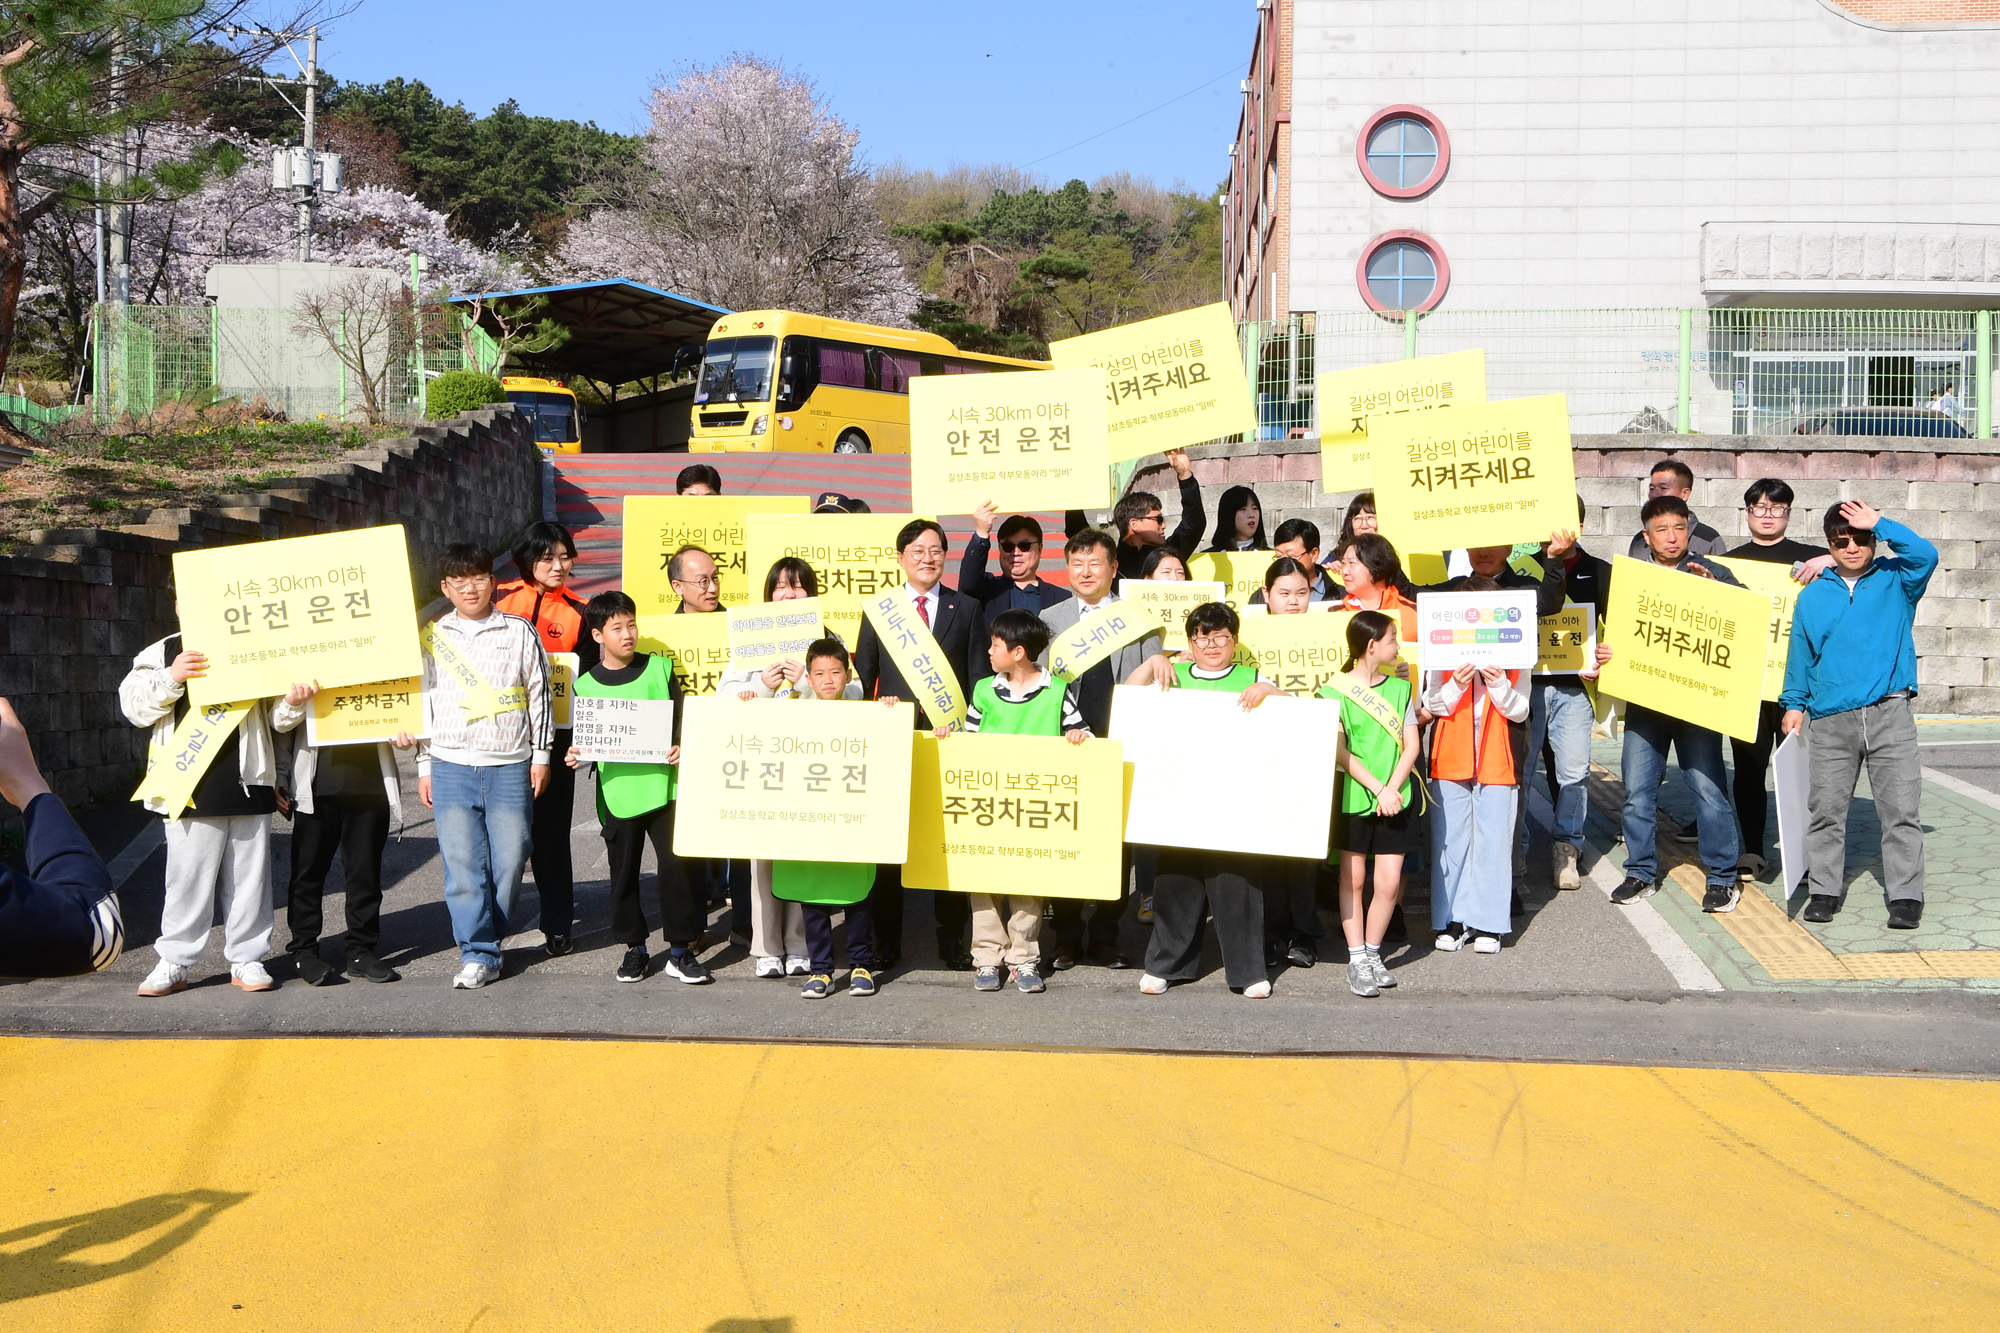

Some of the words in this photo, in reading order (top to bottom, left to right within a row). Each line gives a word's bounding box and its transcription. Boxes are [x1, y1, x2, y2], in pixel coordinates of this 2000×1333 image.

[1141, 338, 1204, 367] 어린이를
[1350, 393, 1391, 412] 길상의
[1396, 382, 1454, 404] 어린이를
[948, 406, 981, 425] 시속
[985, 405, 1032, 422] 30km
[1036, 402, 1070, 421] 이하
[1149, 404, 1194, 422] 학부모동아리
[1406, 438, 1457, 463] 길상의
[1462, 430, 1532, 456] 어린이를
[948, 472, 996, 483] 길상초등학교
[998, 469, 1047, 480] 학부모동아리
[1409, 456, 1536, 493] 지켜주세요
[1412, 507, 1462, 521] 길상초등학교
[1463, 501, 1513, 515] 학부모동아리
[660, 527, 707, 546] 길상의
[713, 527, 747, 546] 어린
[223, 580, 262, 600] 시속
[267, 573, 323, 594] 30km
[327, 564, 366, 586] 이하
[1141, 592, 1159, 602] 시속
[1164, 592, 1189, 602] 30km
[1193, 593, 1211, 603] 이하
[733, 616, 774, 632] 아이들은
[775, 612, 817, 628] 안전보행
[1562, 615, 1580, 627] 이하
[1637, 594, 1677, 623] 길상의
[1680, 606, 1736, 641] 어린이를
[229, 648, 287, 665] 길상초등학교
[289, 639, 347, 656] 학부모동아리
[735, 643, 776, 658] 어른들은
[1633, 619, 1732, 670] 지켜주세요
[878, 597, 918, 650] 모두가
[912, 653, 955, 714] 안전한
[1629, 659, 1667, 680] 길상초등학교
[1668, 672, 1708, 693] 학부모동아리
[334, 692, 410, 712] 주정차금지
[576, 698, 605, 709] 신호를
[609, 700, 638, 711] 지키는
[348, 718, 380, 727] 길상초등학교
[382, 717, 399, 725] 학생회
[575, 710, 598, 721] 일은,
[575, 722, 604, 735] 생명을
[608, 724, 637, 735] 지키는
[175, 728, 209, 772] 길상
[574, 735, 622, 747] 일입니다!!
[726, 733, 764, 755] 시속
[769, 736, 824, 755] 30km
[830, 737, 869, 758] 이하
[945, 769, 999, 791] 어린이
[1004, 772, 1078, 796] 보호구역
[719, 809, 776, 821] 길상초등학교
[779, 811, 836, 823] 학부모동아리
[942, 795, 1079, 831] 주정차금지
[941, 843, 996, 856] 길상초등학교
[997, 846, 1052, 859] 학부모동아리
